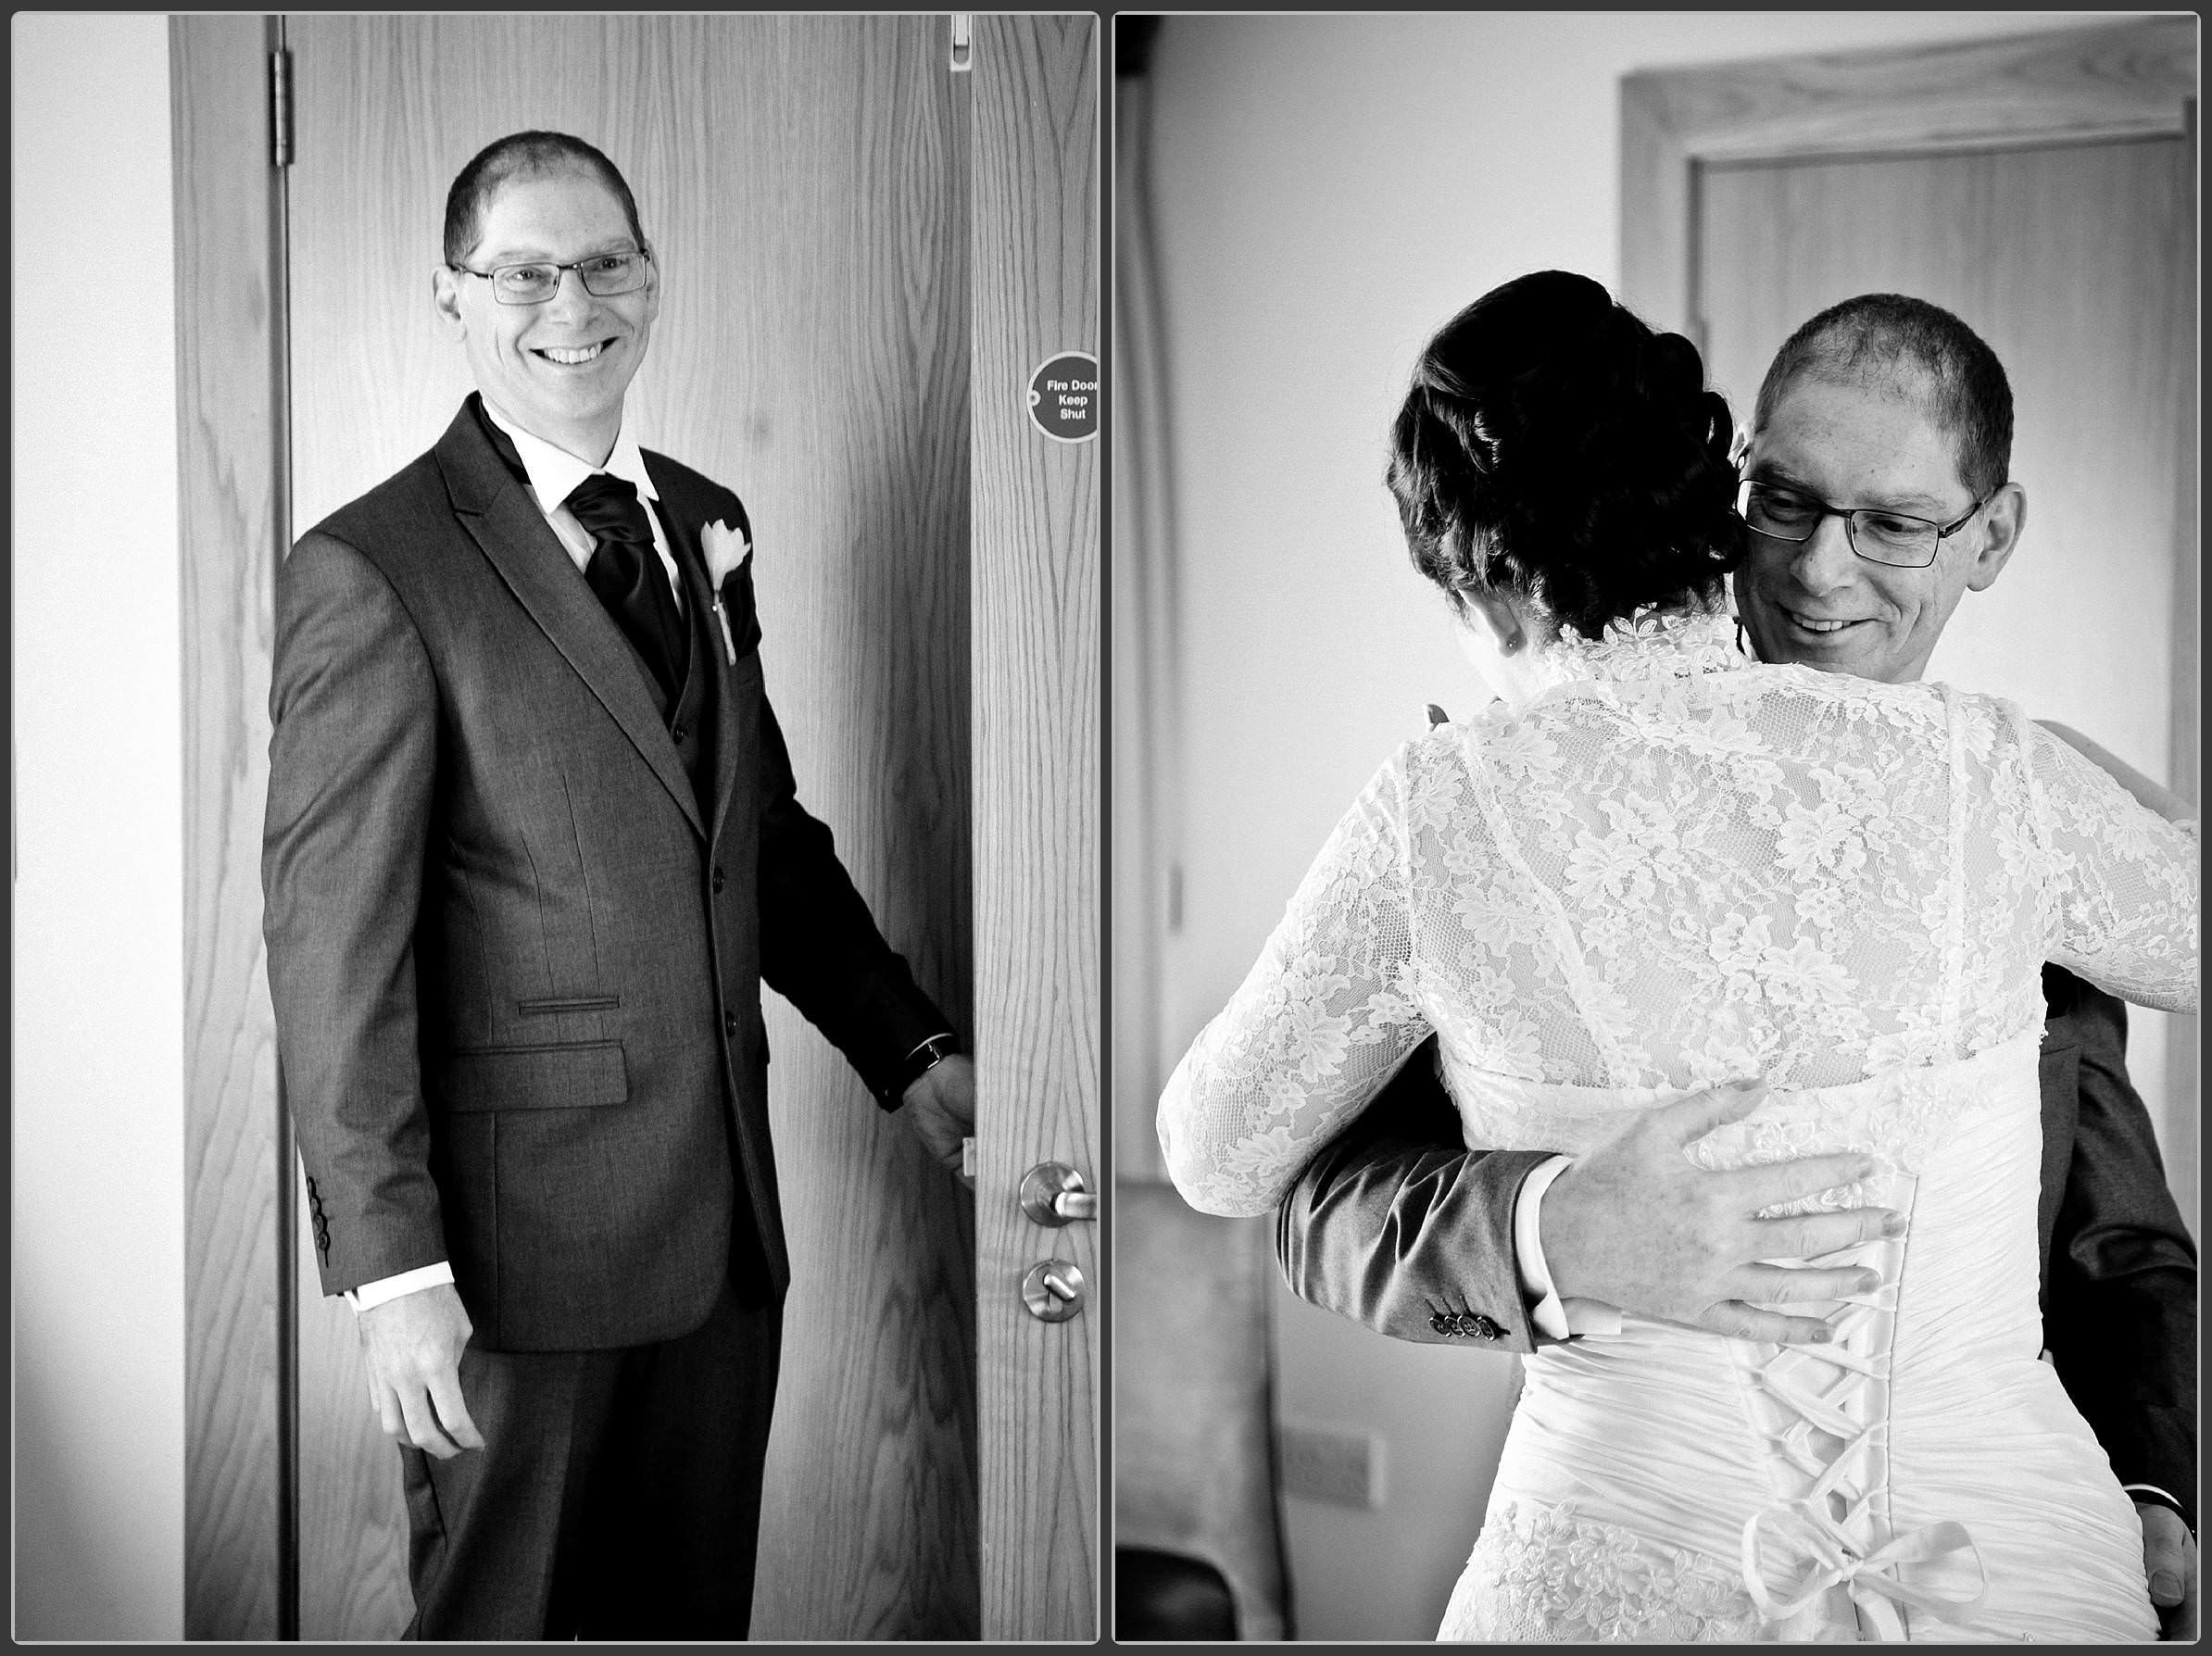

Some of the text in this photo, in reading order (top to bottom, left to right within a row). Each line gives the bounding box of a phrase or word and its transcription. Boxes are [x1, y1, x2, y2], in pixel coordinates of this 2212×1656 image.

[1047, 380, 1068, 391] Fire
[1059, 394, 1087, 407] Keep
[1060, 408, 1086, 420] Shut
